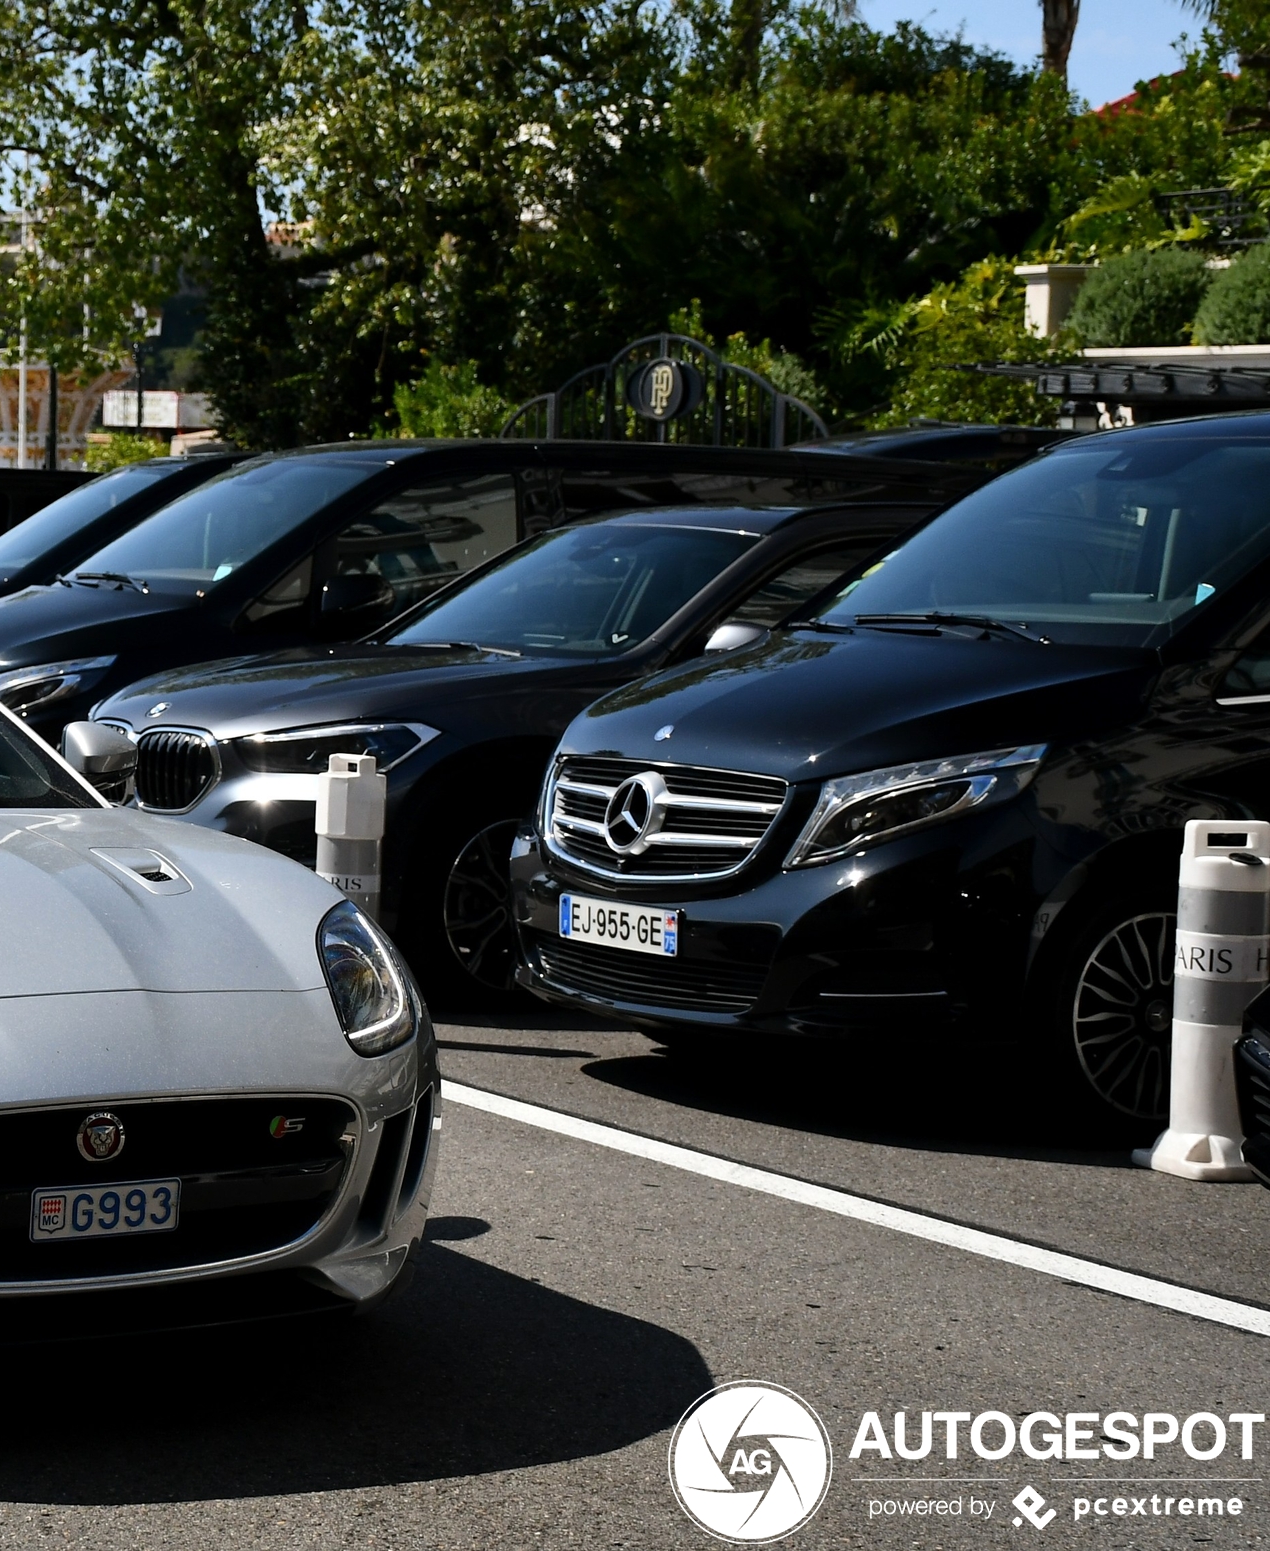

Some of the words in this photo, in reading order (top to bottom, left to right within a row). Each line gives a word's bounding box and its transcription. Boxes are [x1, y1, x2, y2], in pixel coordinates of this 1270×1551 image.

[330, 876, 362, 891] RIS
[1176, 945, 1233, 974] ARIS
[42, 1215, 59, 1226] MC
[72, 1187, 172, 1232] G993
